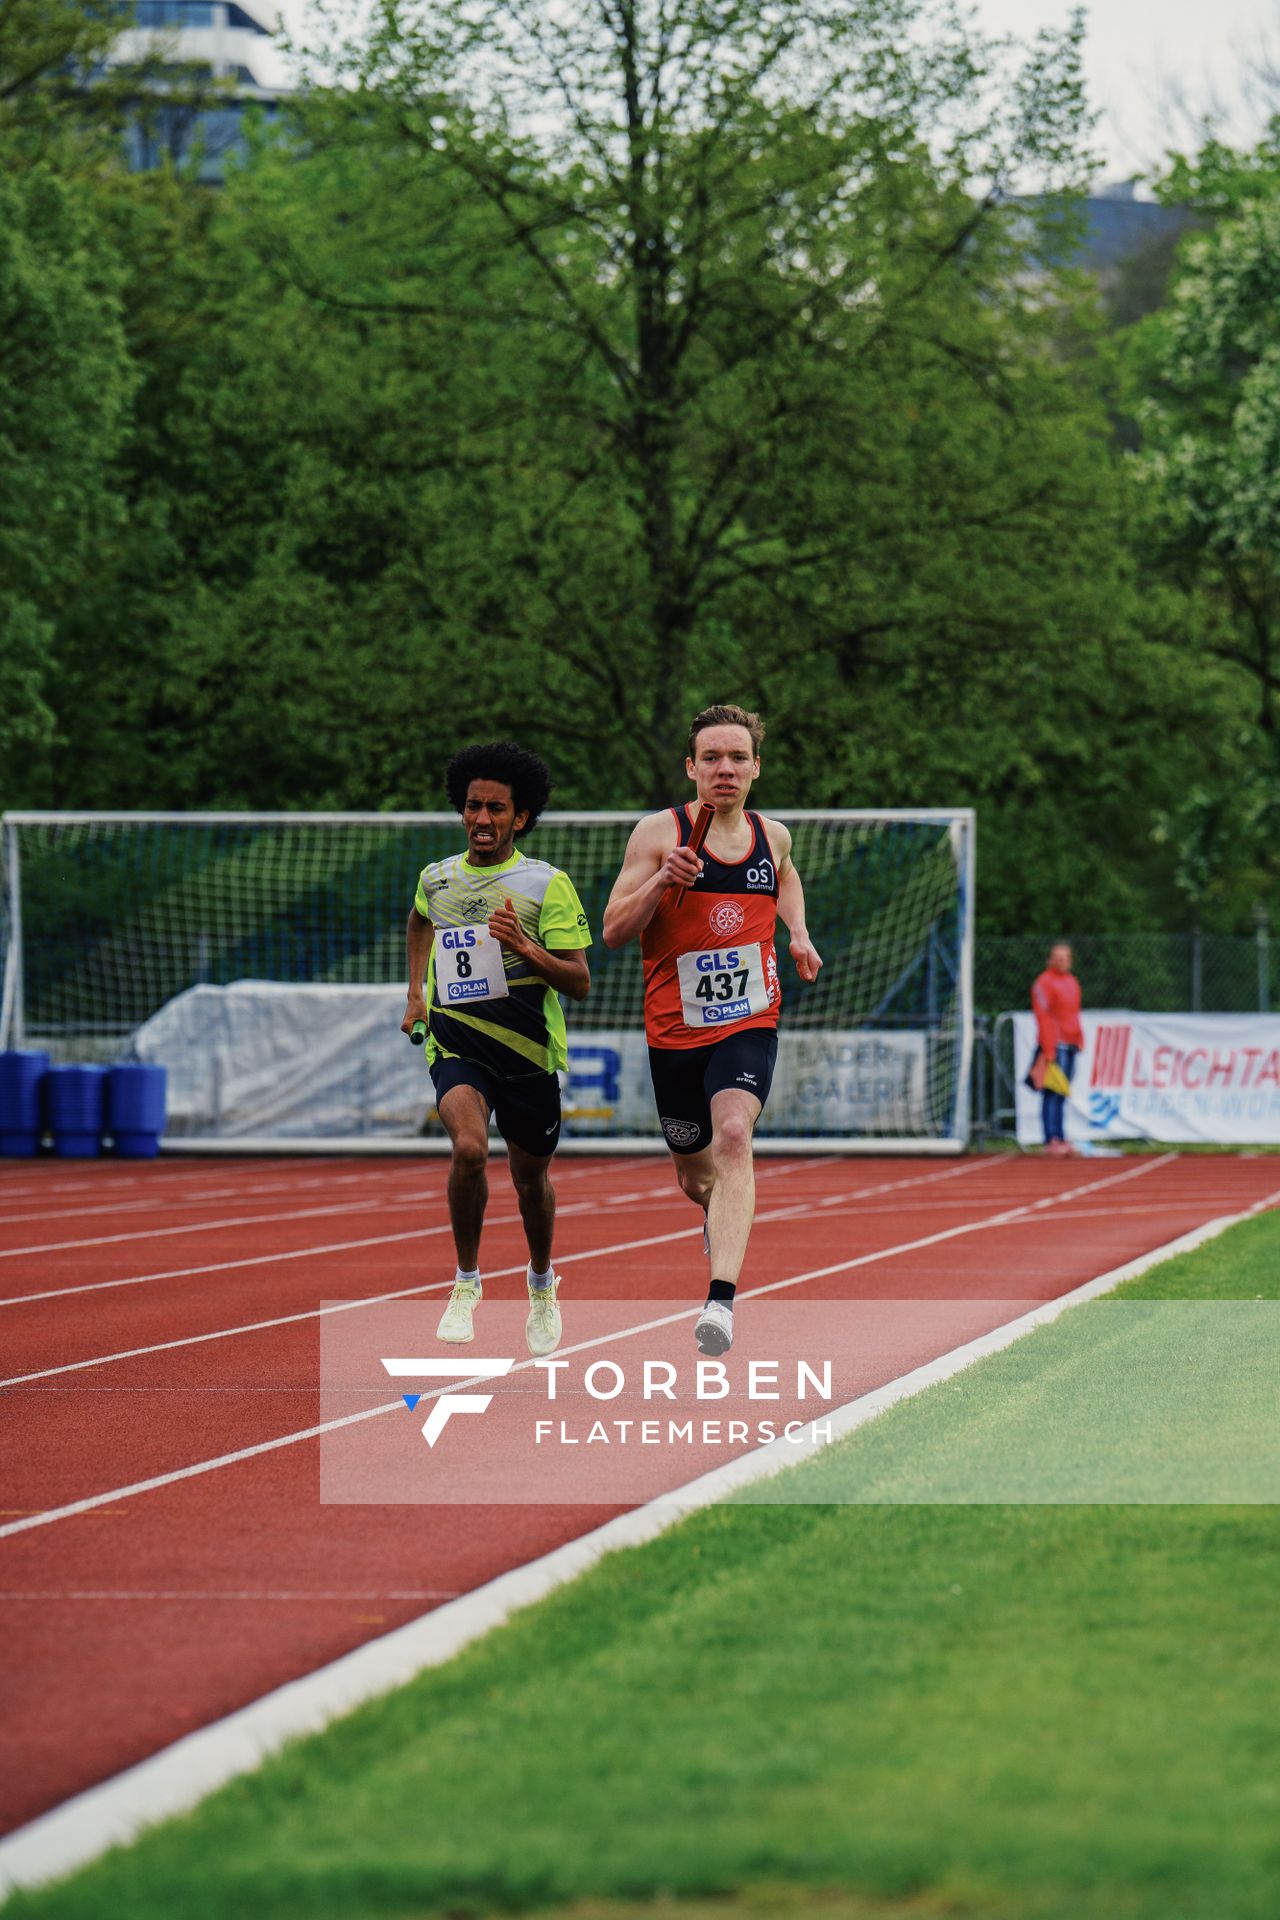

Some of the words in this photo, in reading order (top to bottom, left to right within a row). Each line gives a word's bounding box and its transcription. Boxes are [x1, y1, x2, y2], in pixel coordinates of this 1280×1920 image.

[747, 868, 768, 883] OS
[455, 951, 472, 978] 8
[462, 981, 487, 993] PLAN
[695, 968, 749, 1002] 437
[722, 1002, 748, 1014] PLAN
[736, 1076, 757, 1086] erima
